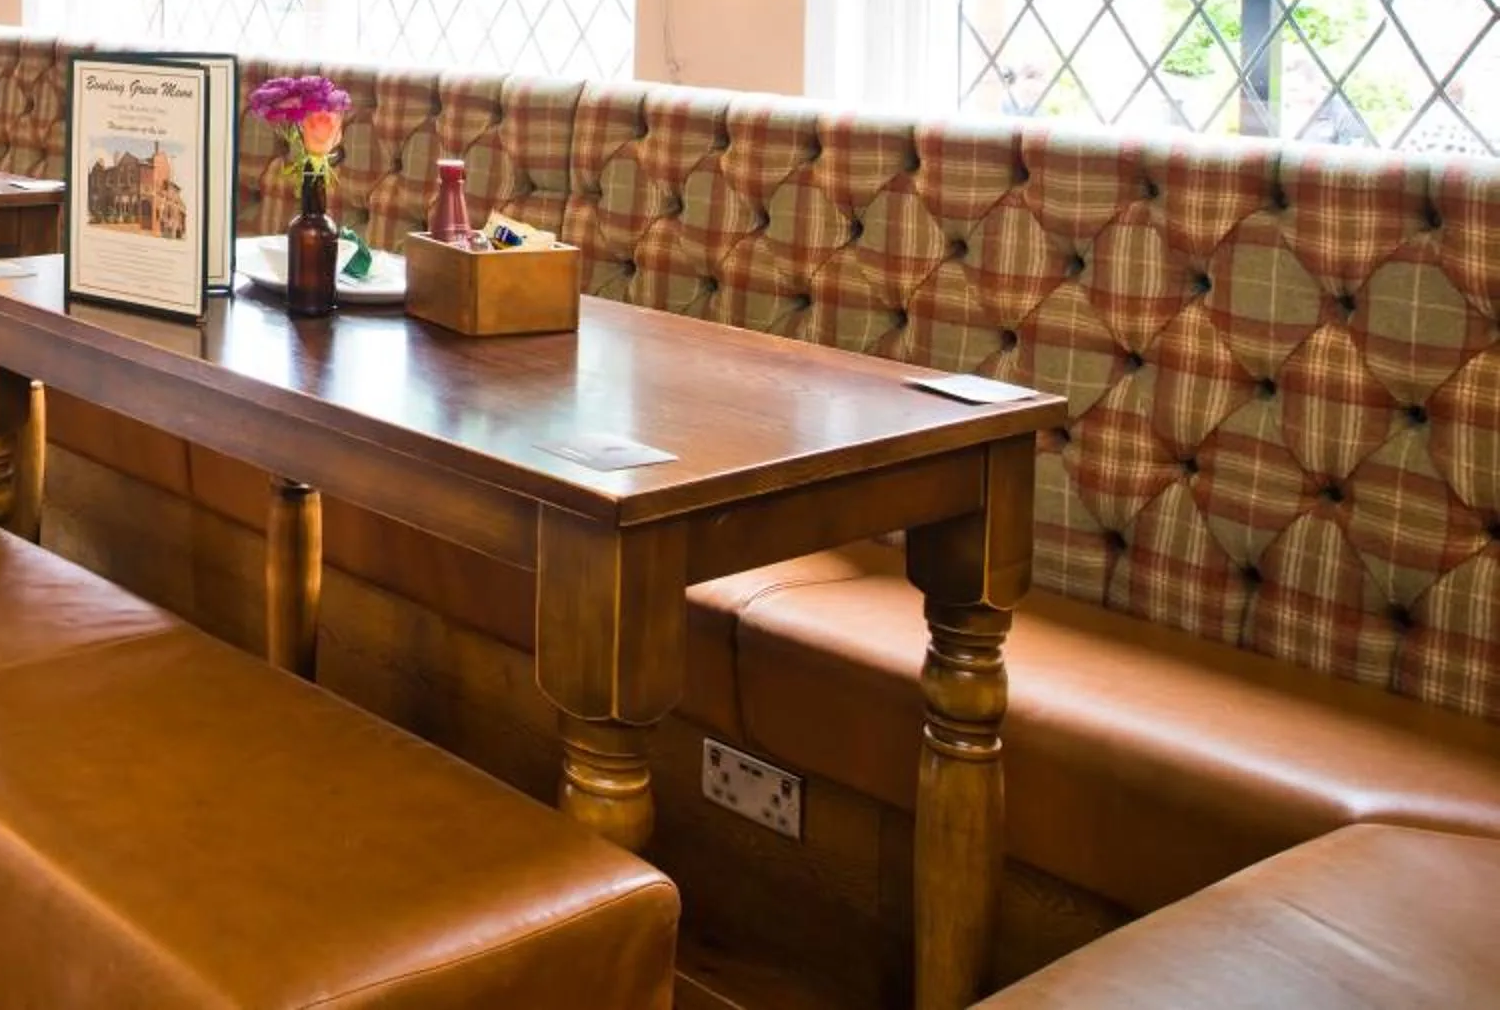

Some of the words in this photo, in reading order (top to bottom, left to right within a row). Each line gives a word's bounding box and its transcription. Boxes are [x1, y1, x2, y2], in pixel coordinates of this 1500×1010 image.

[86, 75, 125, 97] Bowling
[128, 79, 159, 98] Green
[160, 81, 194, 98] Menu
